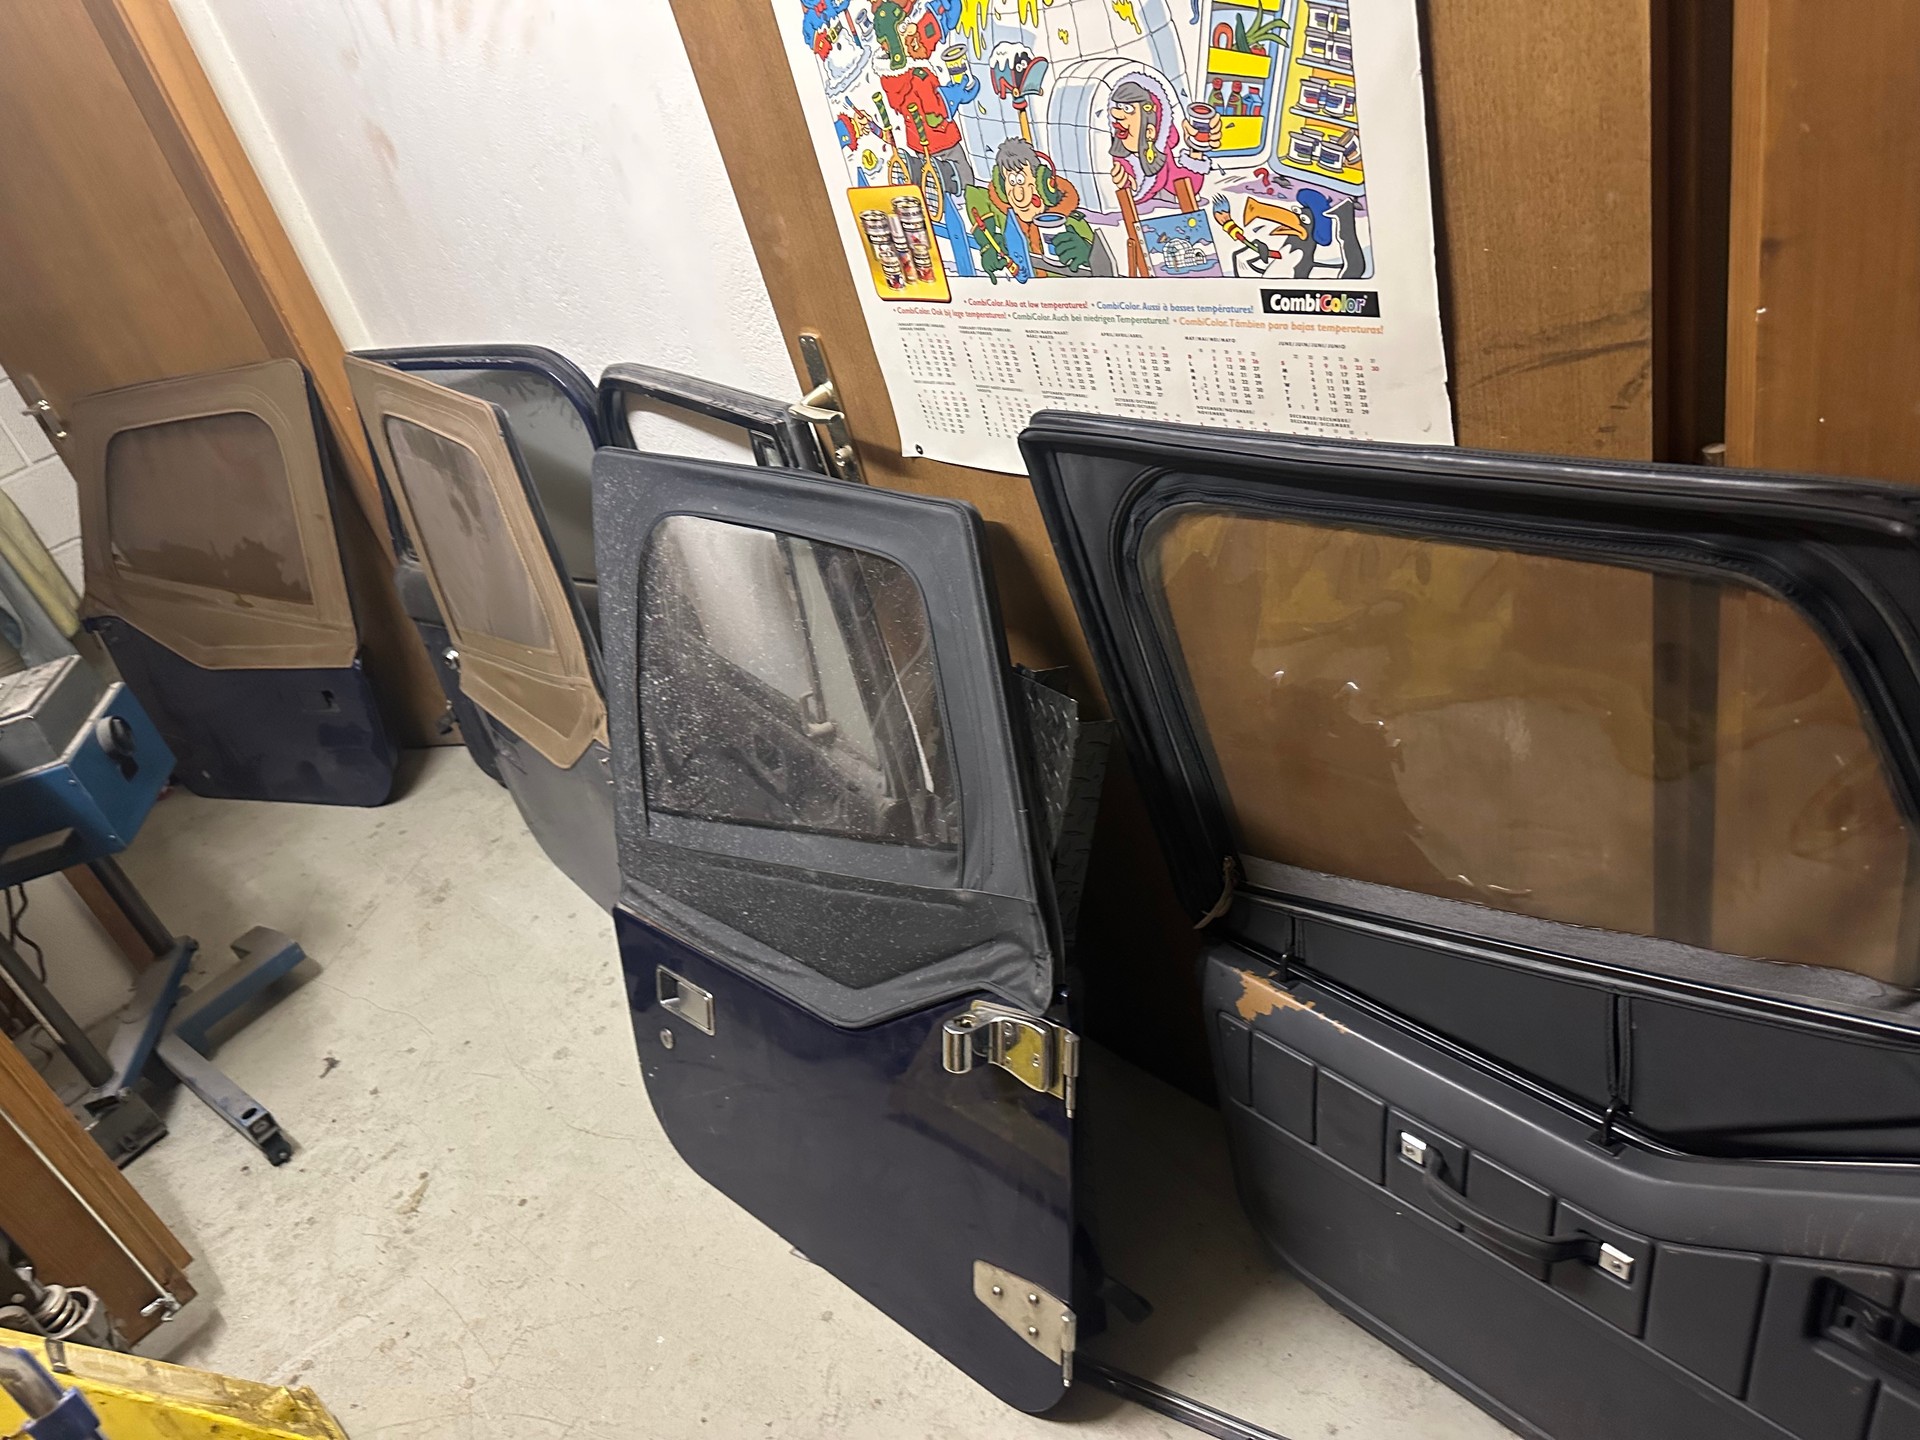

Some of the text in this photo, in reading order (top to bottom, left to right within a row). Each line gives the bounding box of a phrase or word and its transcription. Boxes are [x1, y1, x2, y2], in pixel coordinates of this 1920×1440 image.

[1041, 301, 1088, 310] temperatures!
[1142, 302, 1160, 311] Aussi
[1170, 303, 1195, 312] basses
[1197, 304, 1254, 314] températures!
[1270, 293, 1367, 313] CombiColor
[966, 310, 1006, 320] temperaturen!
[1084, 315, 1115, 324] niedrigen
[1116, 315, 1169, 325] Temperaturen!
[1268, 322, 1288, 331] para
[1291, 322, 1314, 332] bajas
[1317, 324, 1384, 334] temperaturas!
